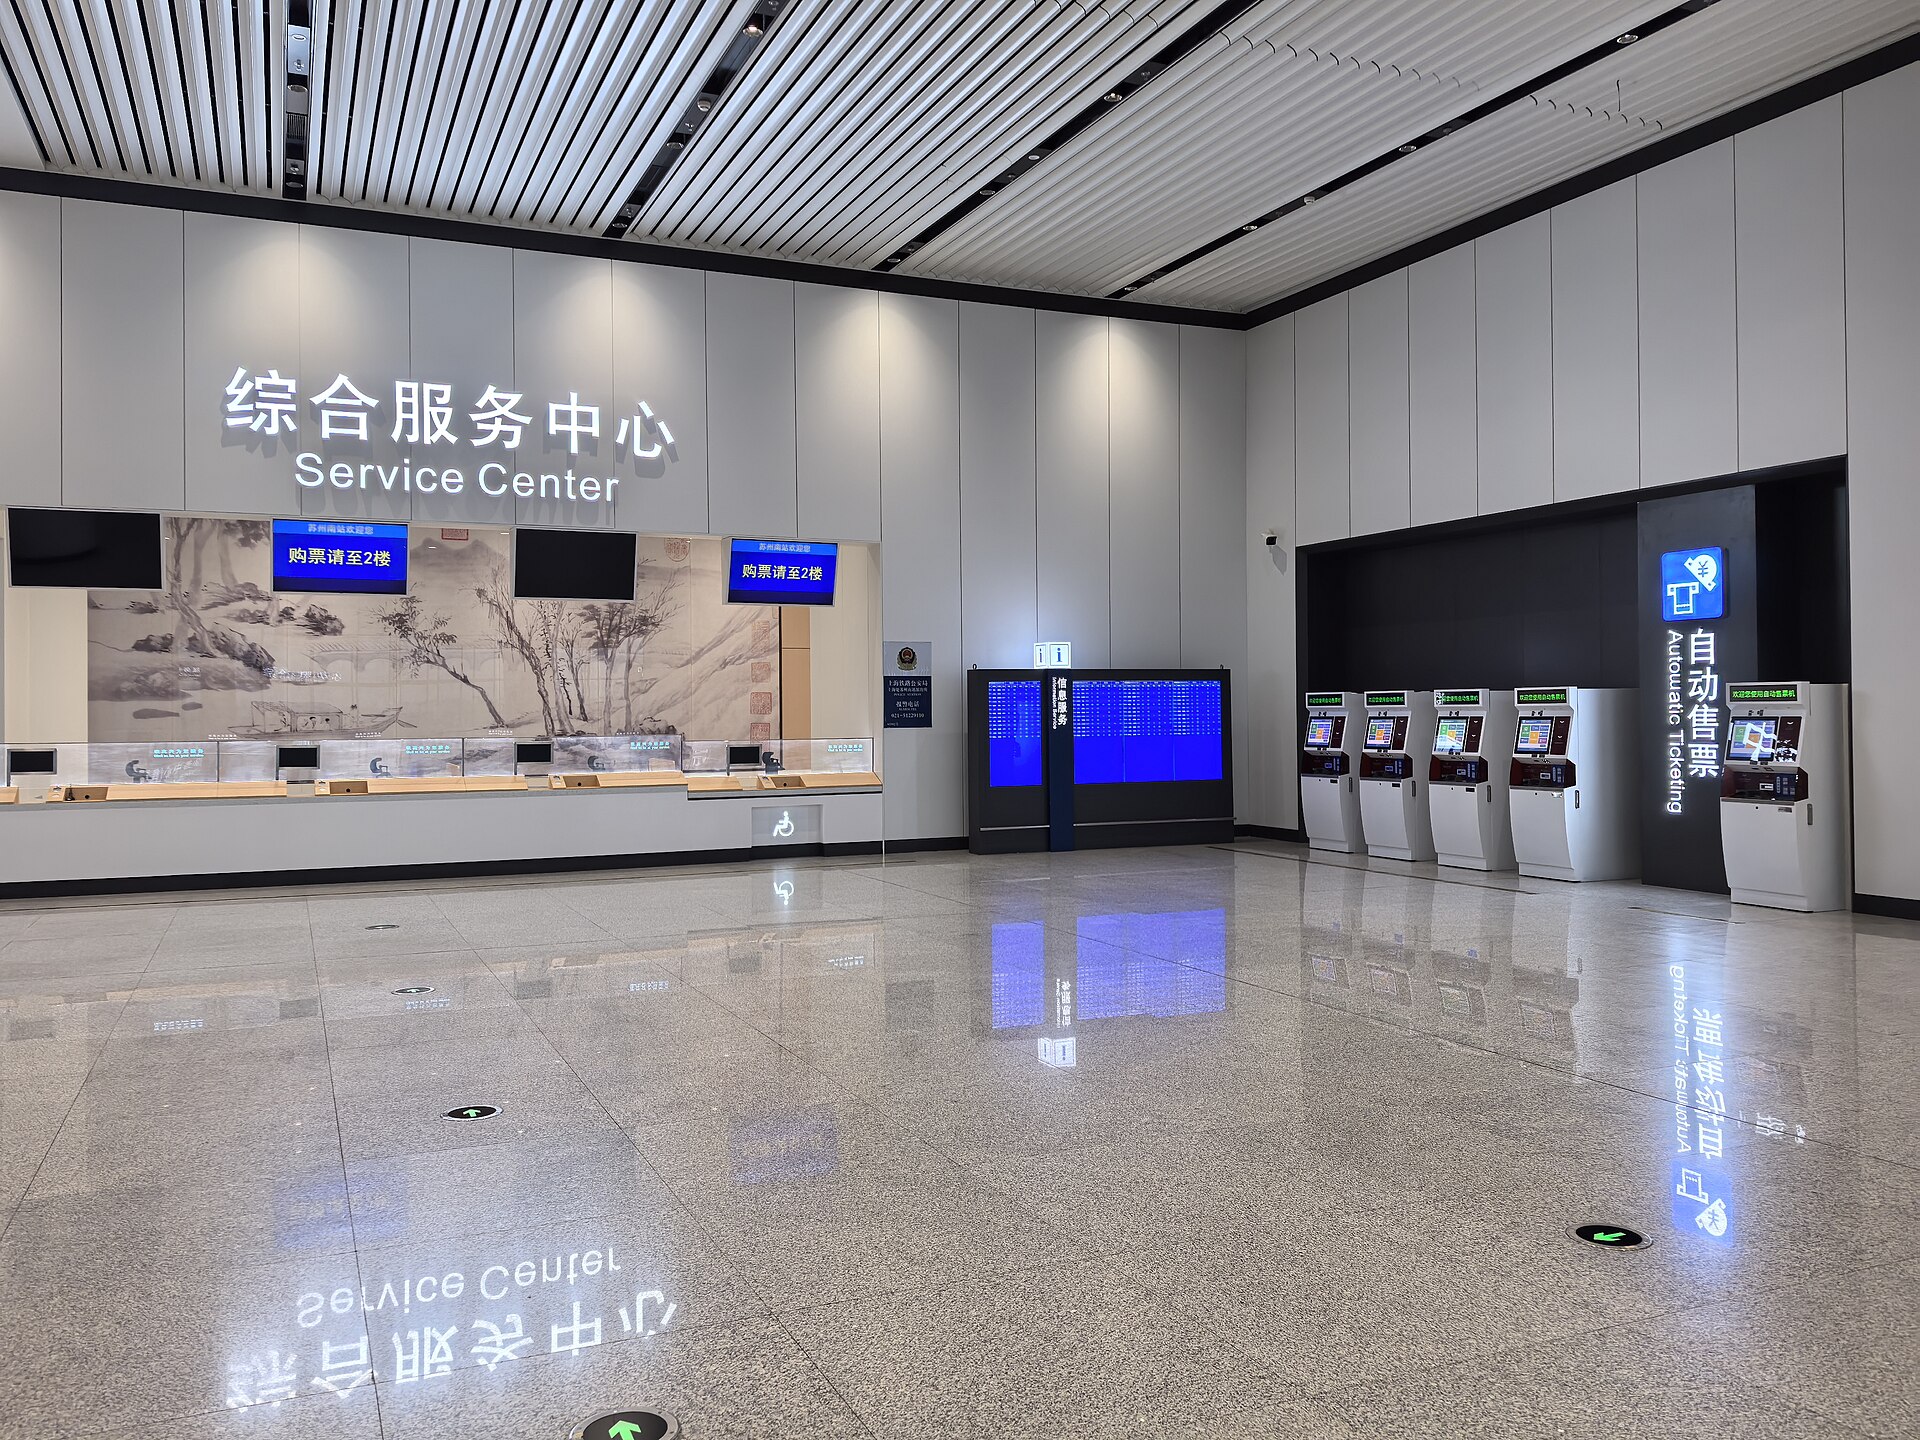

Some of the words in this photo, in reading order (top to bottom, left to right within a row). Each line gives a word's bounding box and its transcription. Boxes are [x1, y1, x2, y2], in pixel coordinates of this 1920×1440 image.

[225, 366, 675, 458] 综合服务中心
[294, 452, 464, 494] Service
[477, 462, 620, 502] Center
[308, 523, 374, 535] 苏州南站欢迎您
[288, 547, 391, 567] 购票请至2楼
[742, 563, 823, 581] 购票请至2楼
[1057, 676, 1068, 726] 信息服务
[1687, 627, 1720, 778] 自动售票
[1666, 729, 1685, 814] Ticketing
